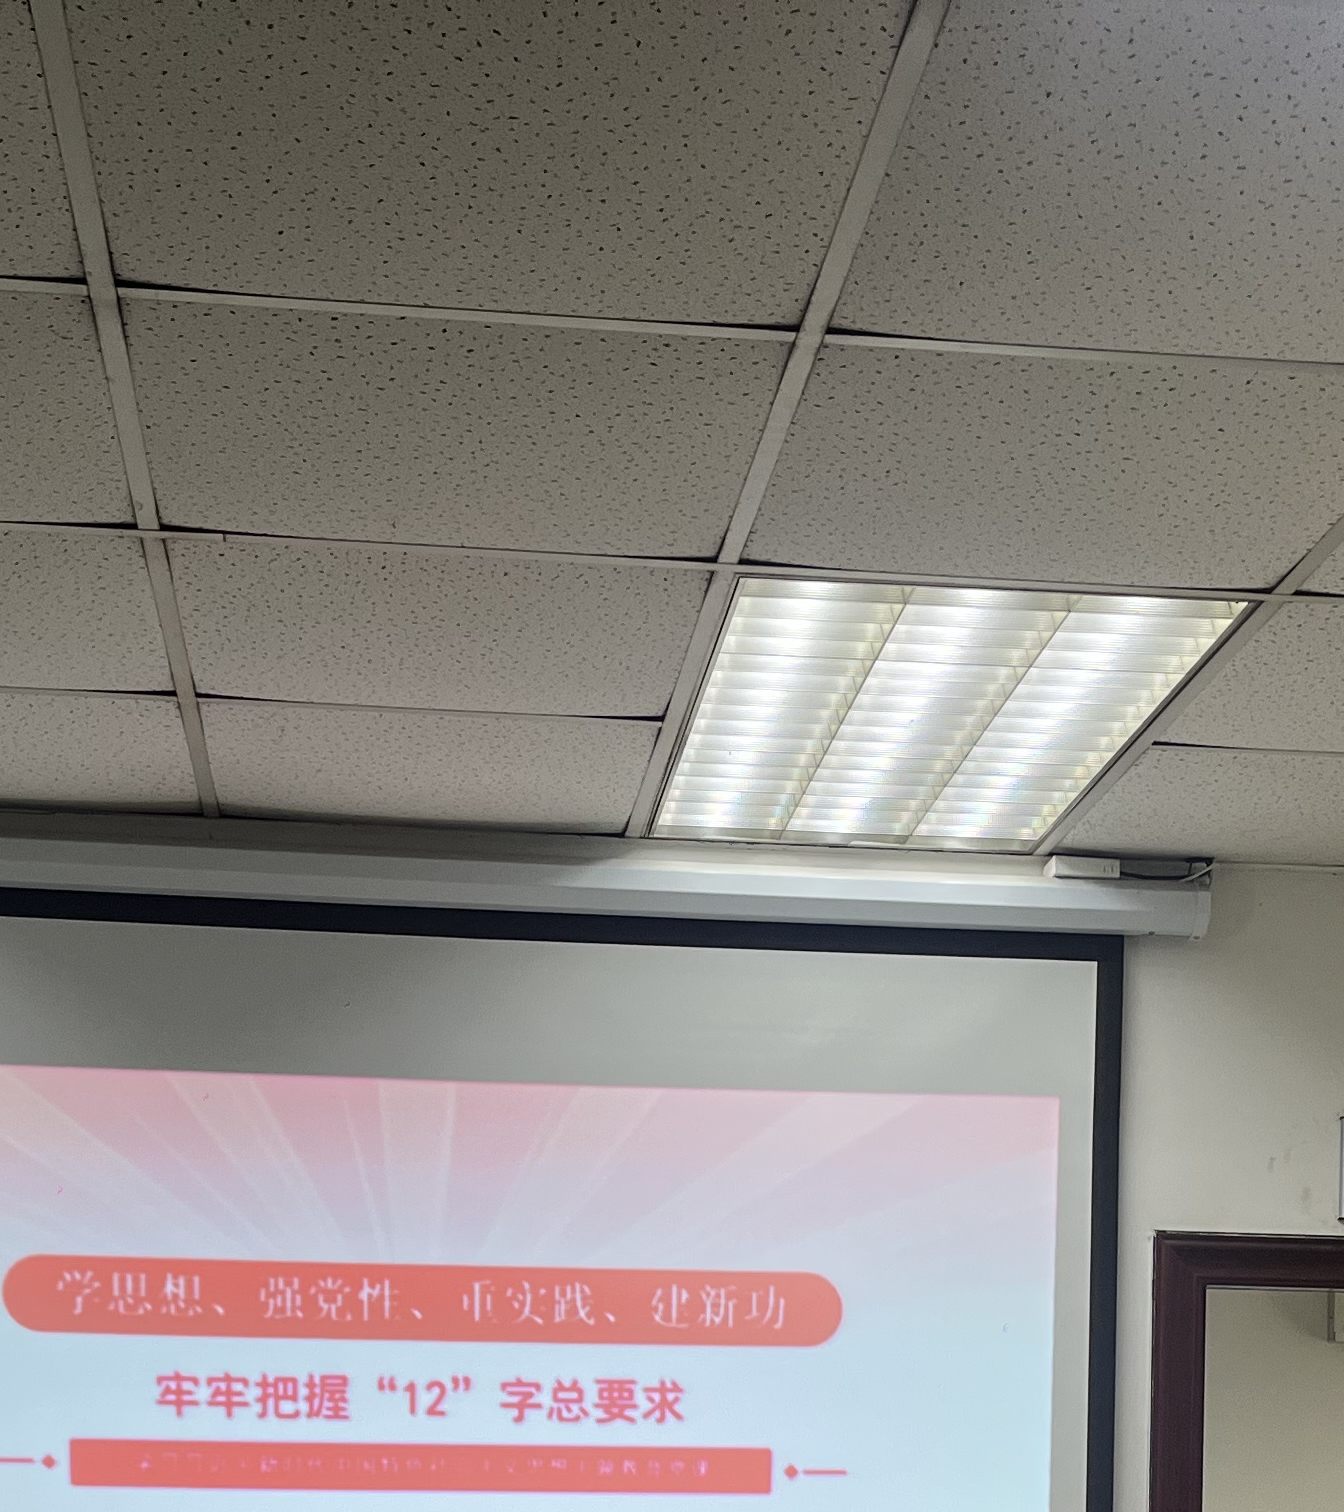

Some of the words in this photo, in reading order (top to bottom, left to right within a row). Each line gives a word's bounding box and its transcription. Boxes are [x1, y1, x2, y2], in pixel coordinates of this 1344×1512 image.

[56, 1269, 785, 1329] 学思想、强党性、重实践、建新功
